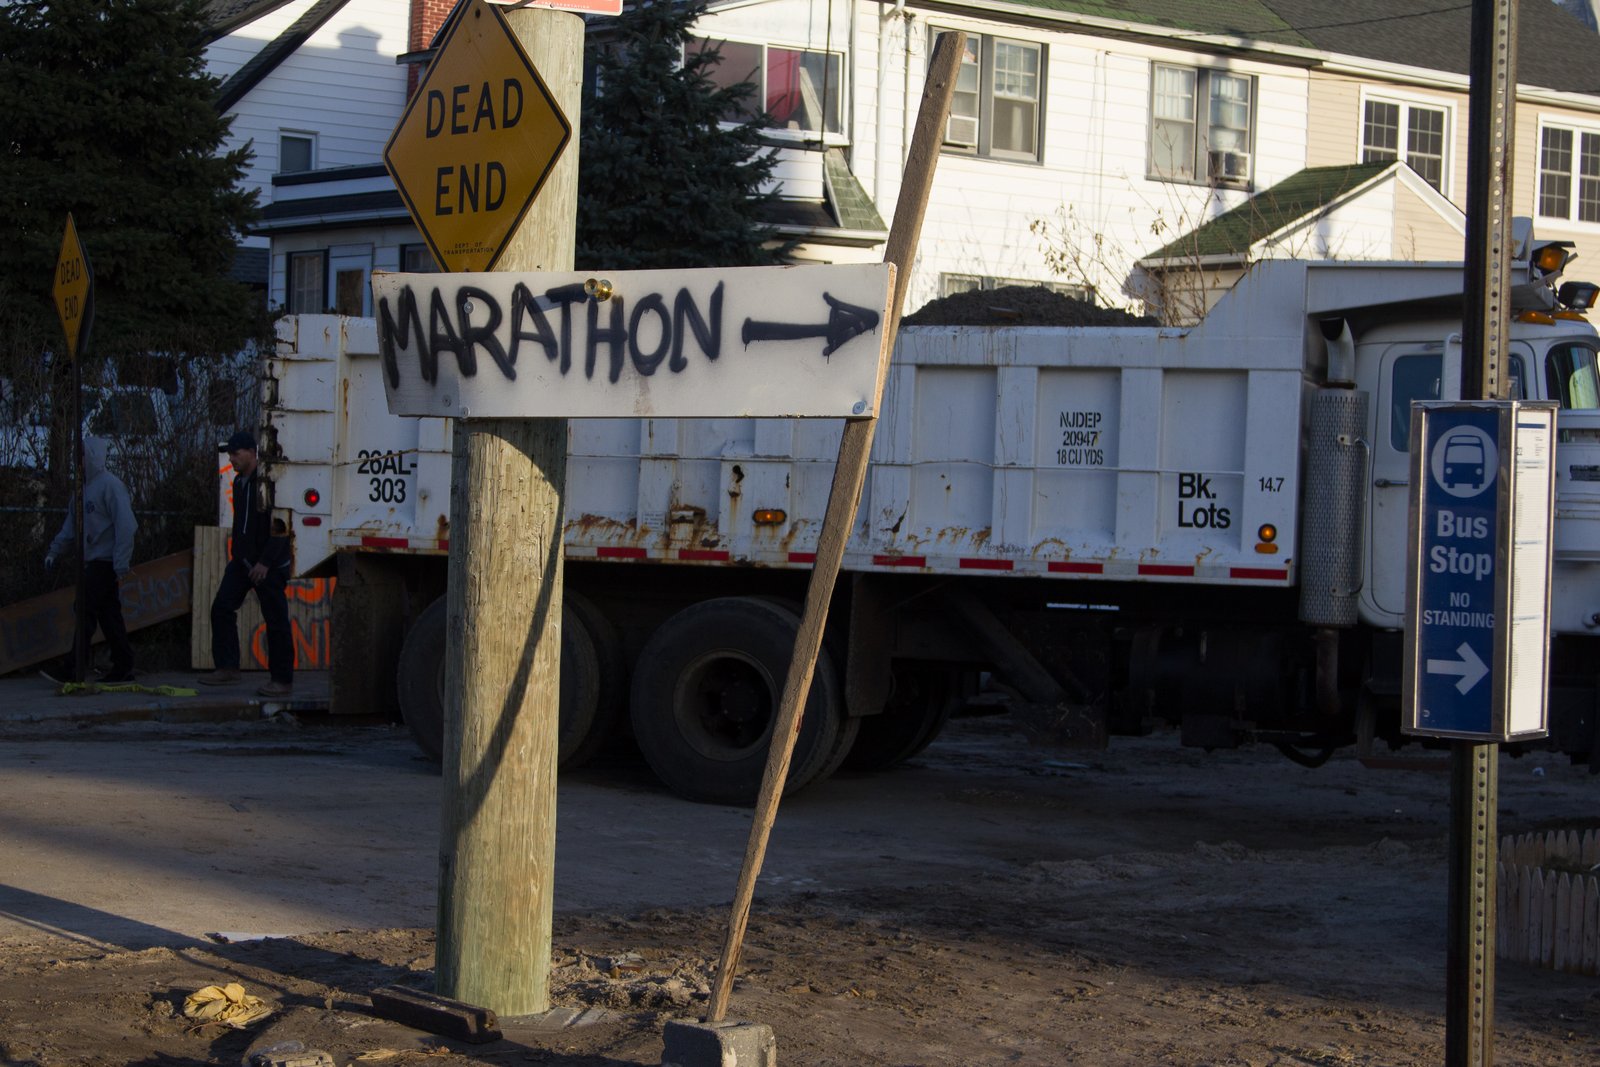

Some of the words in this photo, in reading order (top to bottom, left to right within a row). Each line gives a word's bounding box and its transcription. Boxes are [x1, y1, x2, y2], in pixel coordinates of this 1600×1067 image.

[426, 78, 523, 138] DEAD
[436, 161, 506, 216] END
[61, 257, 80, 285] DEAD
[64, 295, 78, 320] END
[379, 280, 725, 390] MARATHON
[1060, 411, 1102, 428] NJDEP
[1063, 430, 1099, 447] 20947
[1056, 449, 1067, 465] 18
[1068, 449, 1082, 465] CU
[1084, 449, 1104, 466] YDS
[368, 477, 406, 504] 303
[1178, 473, 1216, 499] Bk.
[1258, 477, 1285, 493] 14.7
[1178, 500, 1231, 529] Lots
[1437, 510, 1488, 539] Bus
[1430, 545, 1492, 581] Stop
[119, 568, 192, 621] SHOOT
[1450, 592, 1470, 608] NO
[1423, 610, 1495, 628] STANDING
